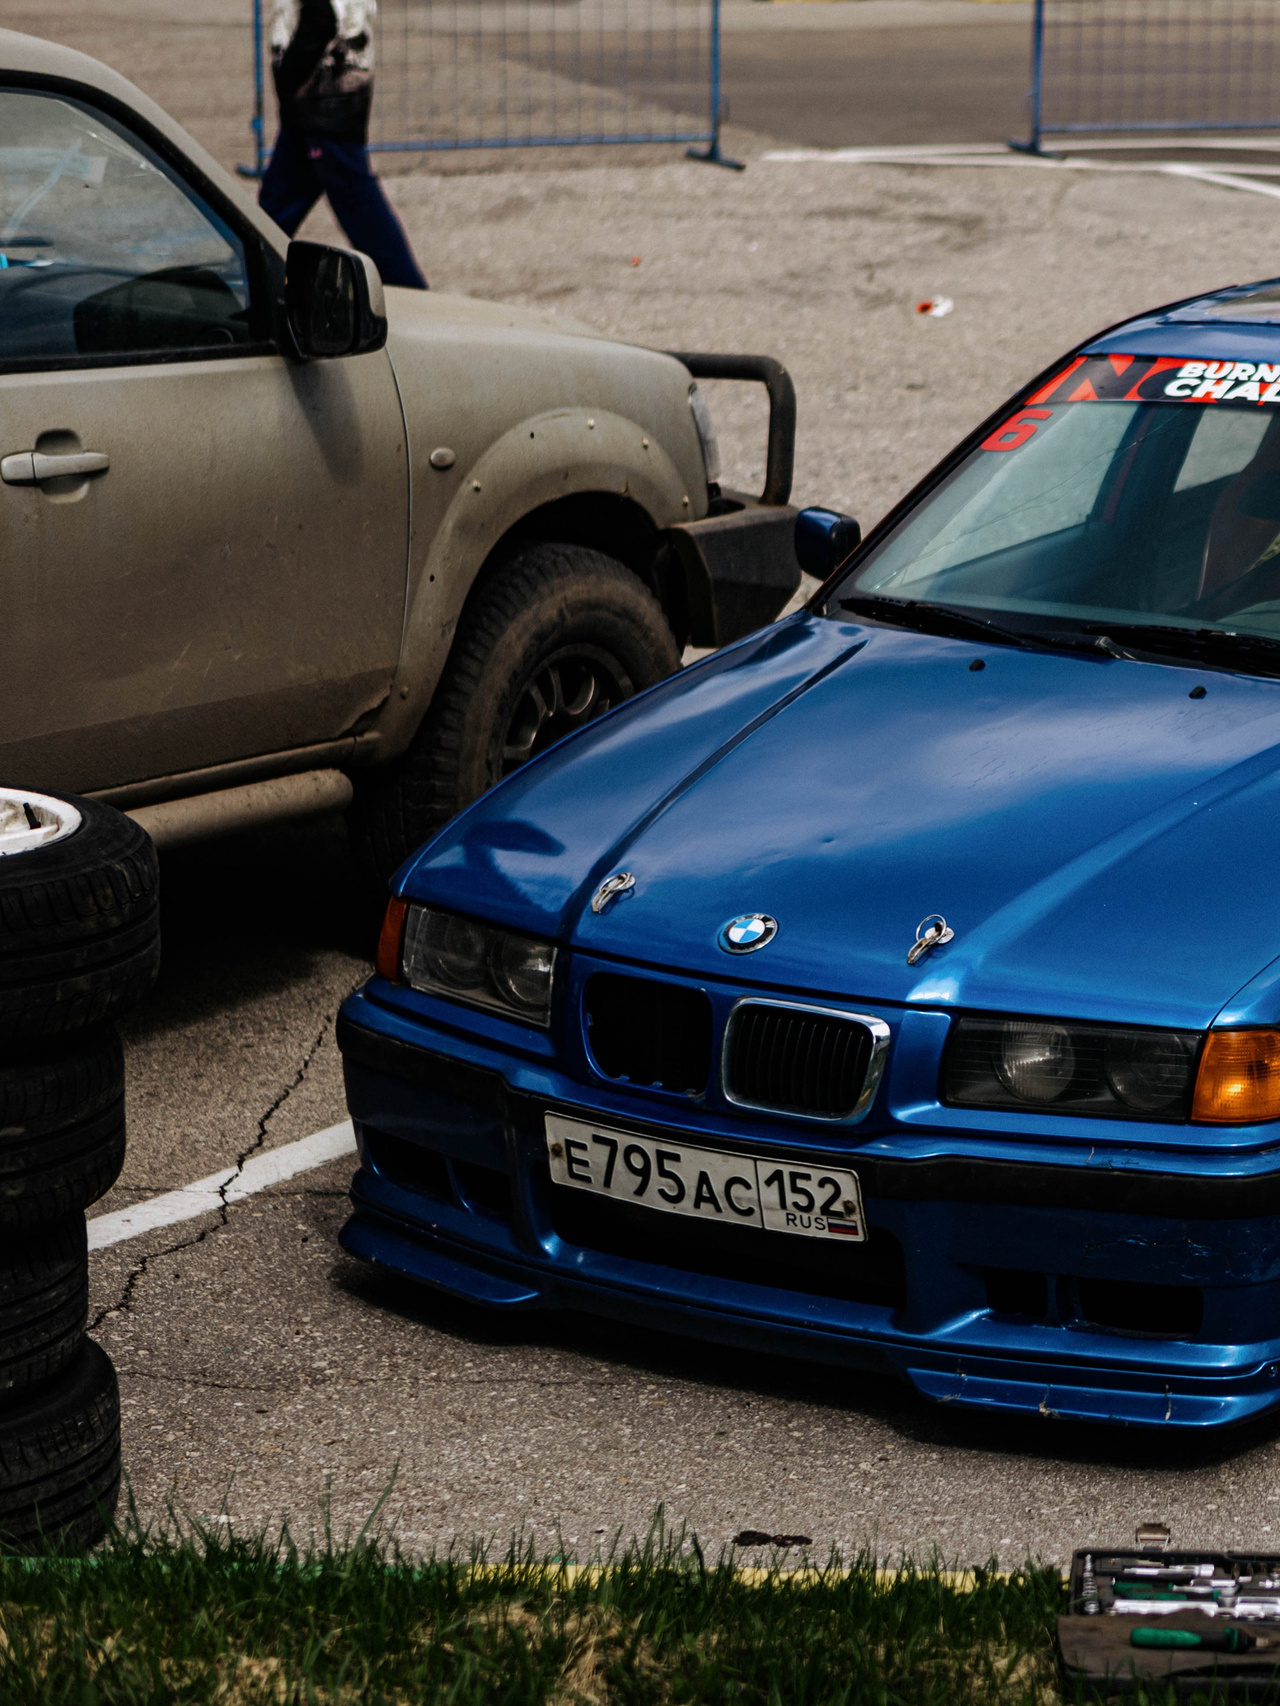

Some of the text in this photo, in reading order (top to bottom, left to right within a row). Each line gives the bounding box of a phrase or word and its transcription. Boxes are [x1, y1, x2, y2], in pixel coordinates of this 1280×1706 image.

[980, 408, 1054, 452] 6
[763, 1168, 845, 1218] 152
[786, 1212, 826, 1231] RUS
